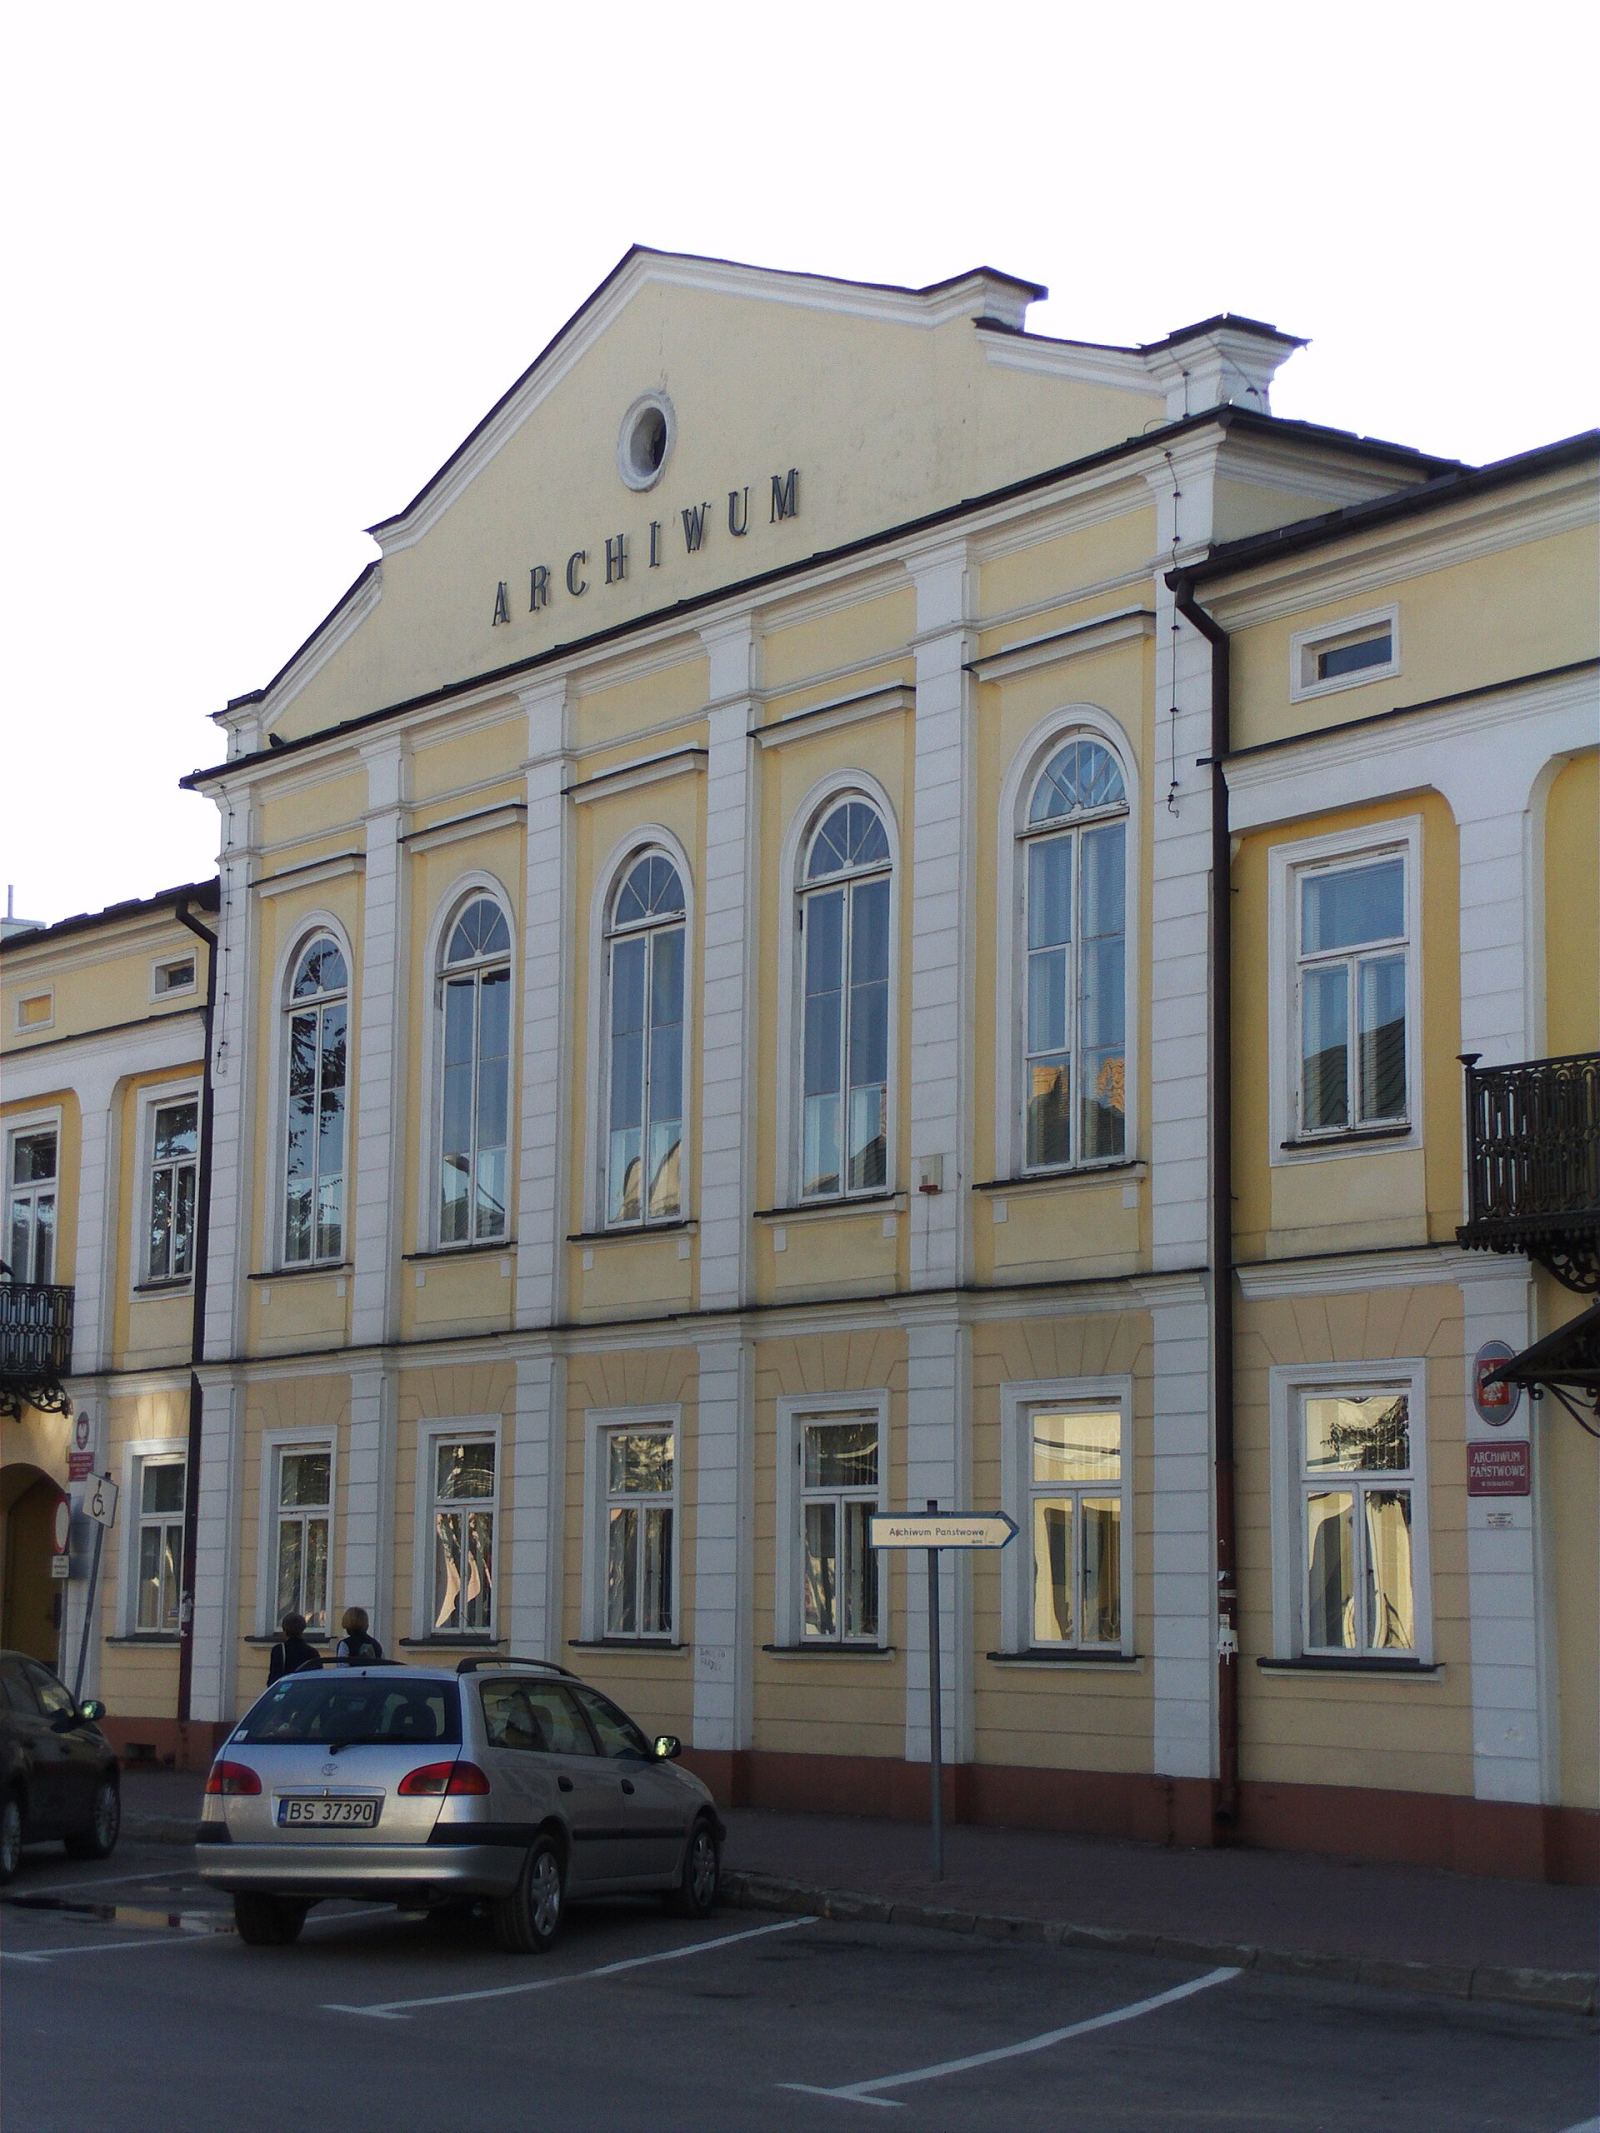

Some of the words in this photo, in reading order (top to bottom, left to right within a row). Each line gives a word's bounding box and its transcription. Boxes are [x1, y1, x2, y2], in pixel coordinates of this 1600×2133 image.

[491, 467, 800, 627] ARCHIWUM
[1473, 1451, 1520, 1463] ARCHIWUM
[1470, 1463, 1525, 1477] PAŃSTWOWE
[290, 1803, 315, 1820] BS
[322, 1803, 373, 1820] 37390
